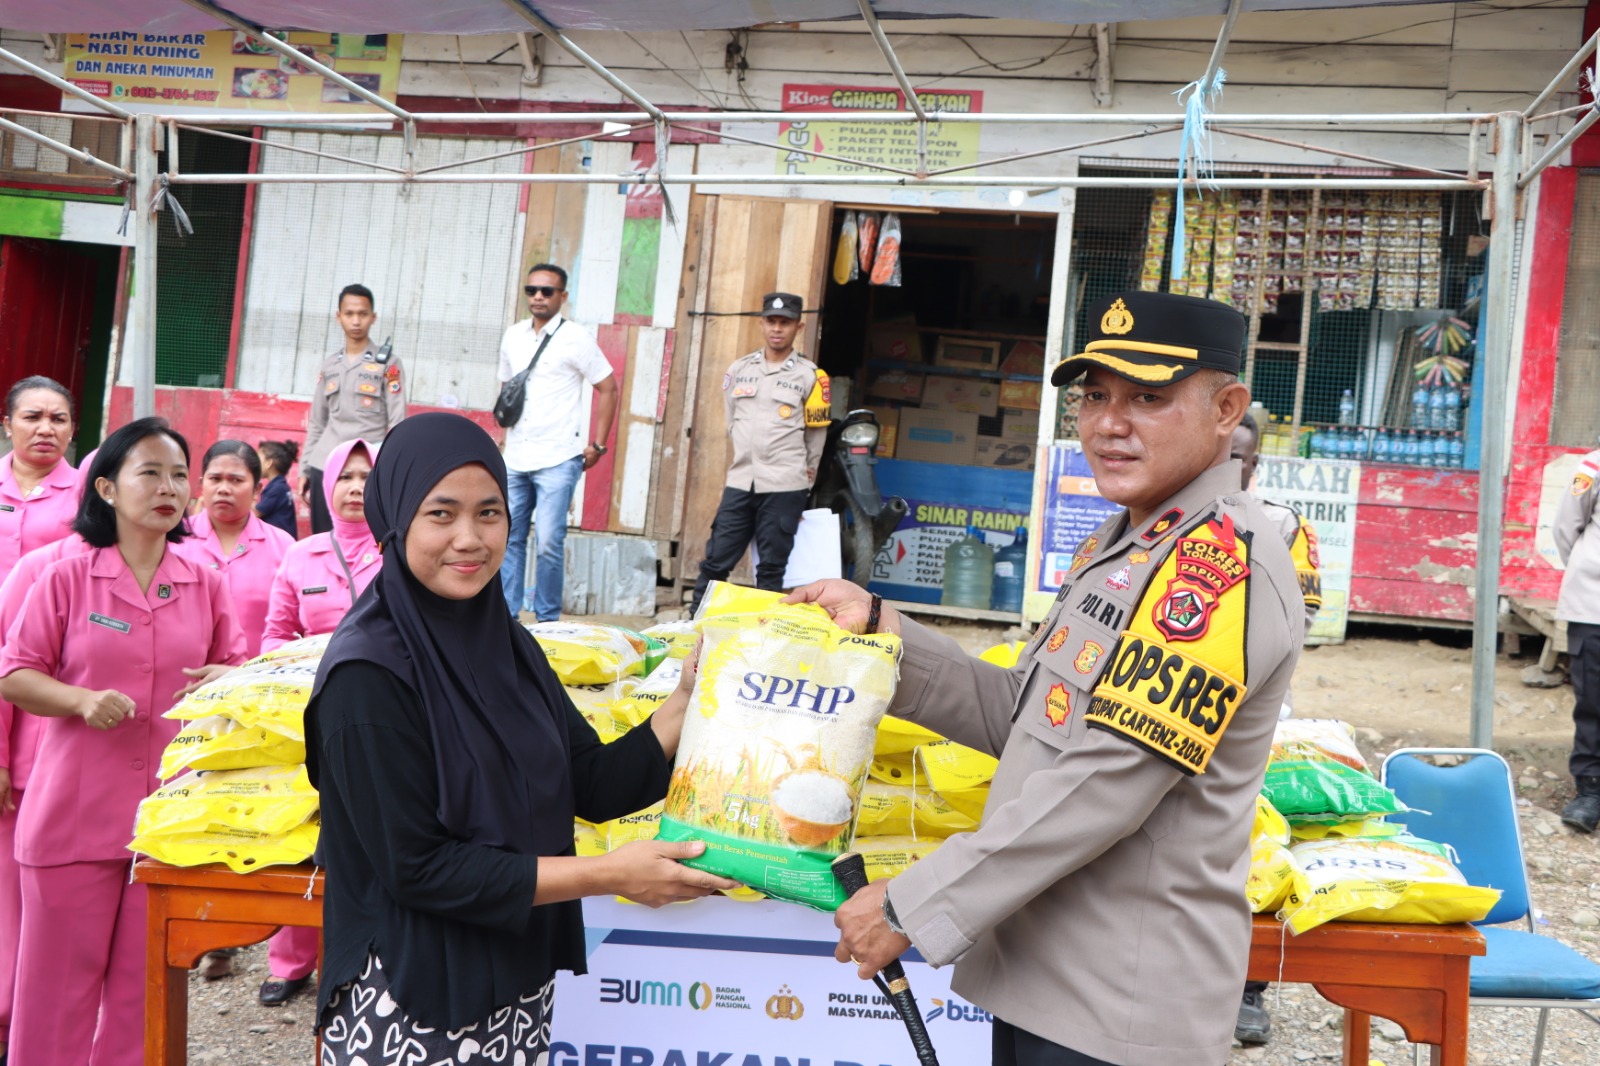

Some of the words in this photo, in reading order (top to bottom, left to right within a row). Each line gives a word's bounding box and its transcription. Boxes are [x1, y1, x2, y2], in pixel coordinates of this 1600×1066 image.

[144, 33, 206, 45] BAKAR
[88, 43, 127, 55] NASI
[134, 45, 200, 59] KUNING
[76, 60, 102, 72] DAN
[105, 62, 147, 75] ANEKA
[152, 65, 214, 79] MINUMAN
[788, 91, 829, 106] Kios
[831, 90, 898, 110] CAHAYA
[839, 127, 888, 135] PULSA
[888, 129, 938, 137] BIAA
[838, 136, 886, 144] PAKET
[890, 138, 958, 148] TELPON
[837, 146, 886, 154] PAKET
[776, 381, 803, 393] POLRI
[916, 505, 968, 526] SINAR
[972, 510, 1030, 531] RAHMA
[1286, 500, 1347, 522] STRIK
[920, 528, 967, 537] SEMBA
[918, 543, 948, 551] PAK
[1182, 541, 1244, 575] POLRES
[1186, 550, 1232, 577] TOLIKARA
[1181, 564, 1222, 588] PAPUA
[1076, 592, 1124, 631] POLRI
[737, 671, 855, 716] SPHP
[726, 801, 741, 821] 5
[742, 810, 760, 829] kg
[688, 836, 722, 850] Cangan
[724, 844, 744, 855] Beras
[746, 849, 788, 864] Pemerintah
[1305, 858, 1406, 871] SPHP
[716, 986, 741, 994] BADAN
[716, 994, 746, 1002] PANGAN
[828, 992, 868, 1004] POLRI
[716, 1002, 752, 1010] NASIONAL
[828, 1006, 903, 1020] MASYARAK
[946, 999, 994, 1023] bulo
